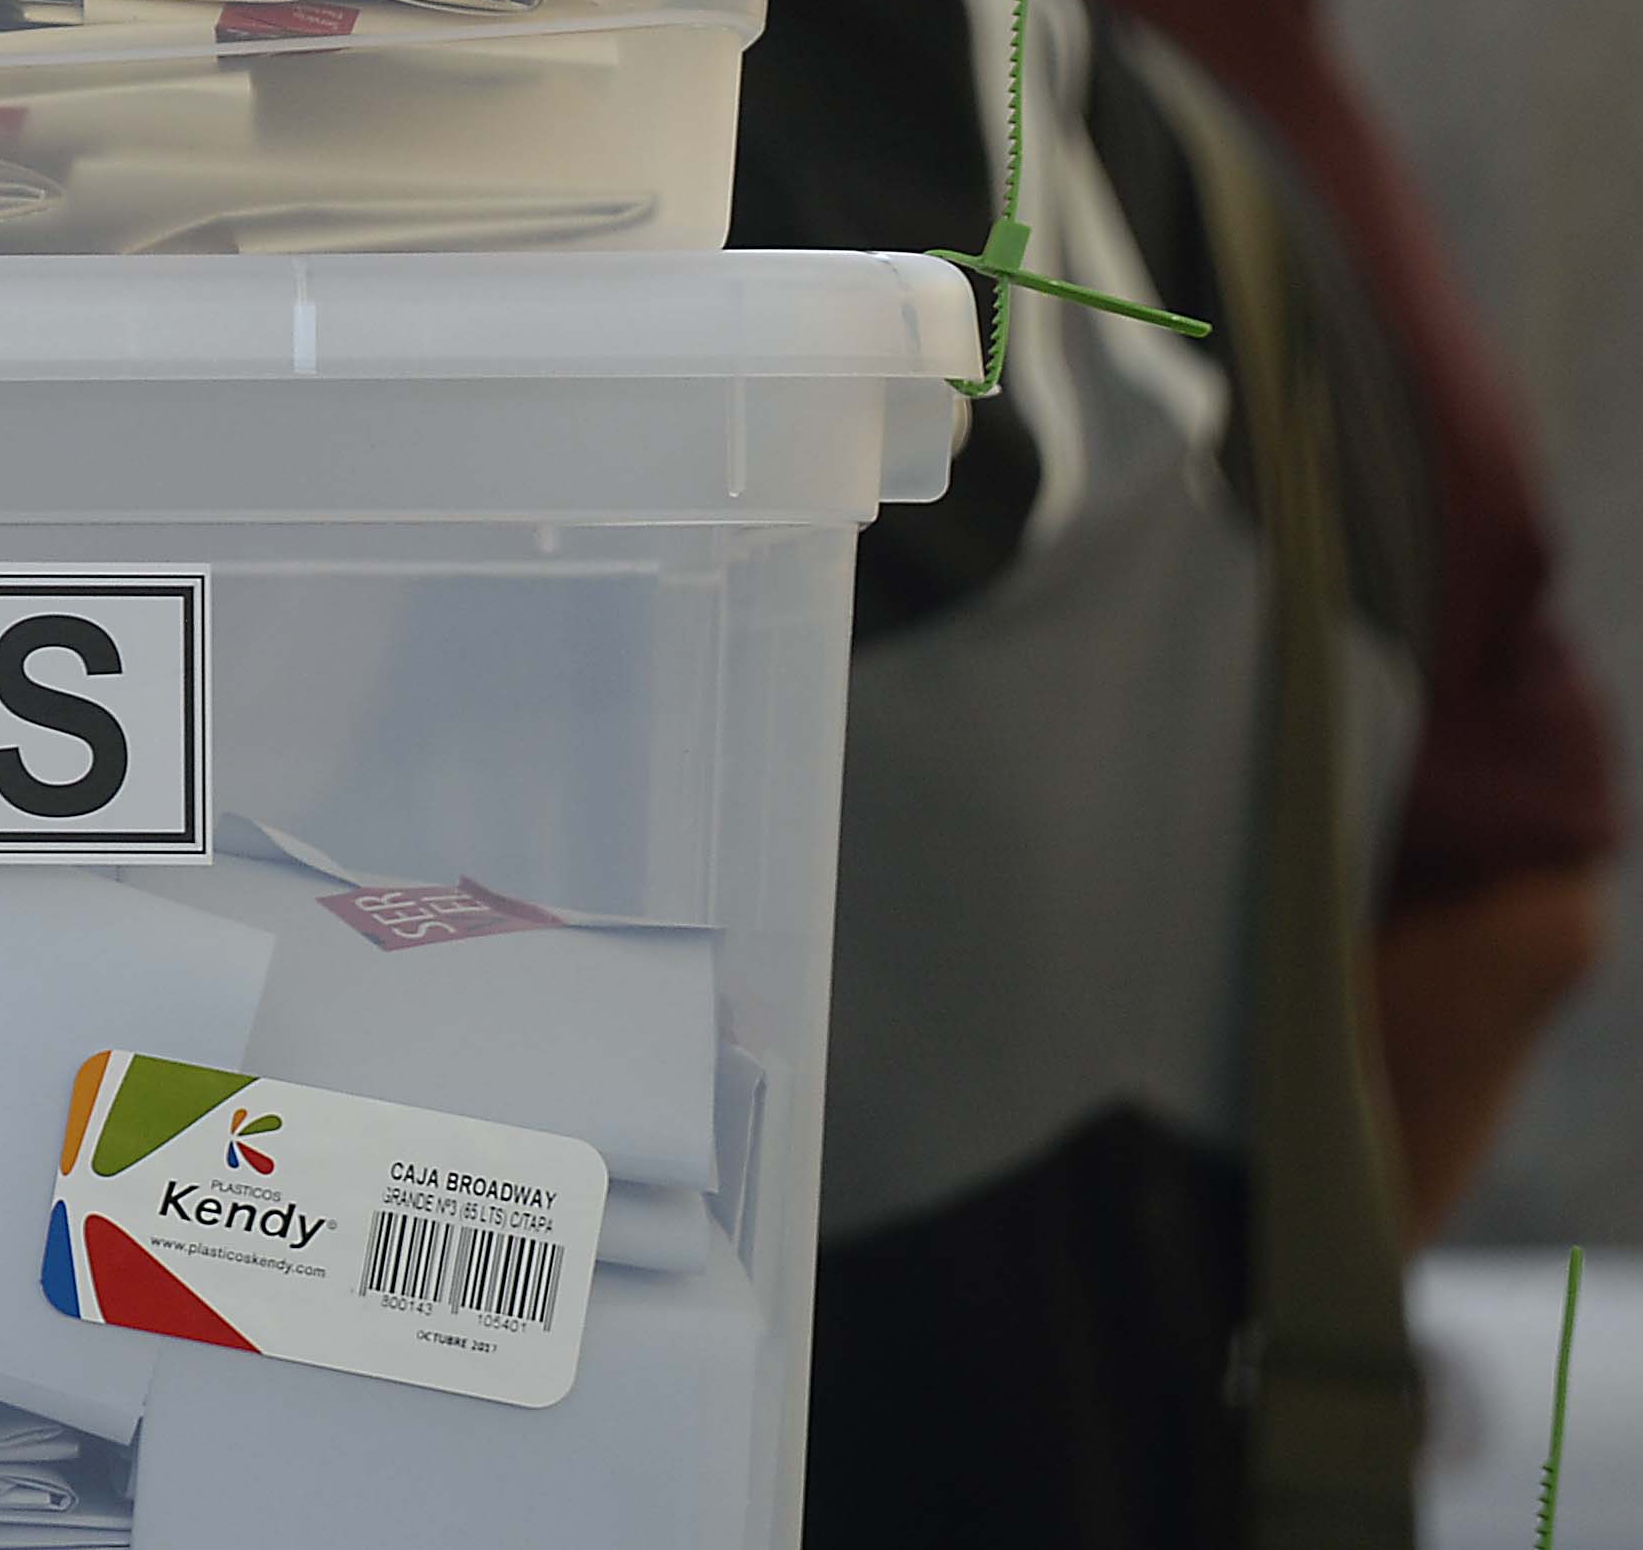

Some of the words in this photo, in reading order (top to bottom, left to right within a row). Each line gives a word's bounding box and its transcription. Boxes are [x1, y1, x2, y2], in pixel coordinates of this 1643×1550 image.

[355, 892, 457, 939] SER
[211, 1180, 282, 1202] PLASTICOS
[382, 1187, 434, 1212] GRANDE
[391, 1162, 439, 1188] CAJA
[446, 1172, 557, 1210] BROADWAY
[158, 1180, 326, 1249] Kendy
[150, 1236, 326, 1278] www.plasticoskendy.com
[381, 1295, 433, 1316] 800143
[478, 1314, 527, 1332] 105401
[416, 1330, 467, 1349] OCTUBRE
[471, 1339, 497, 1353] 2017
